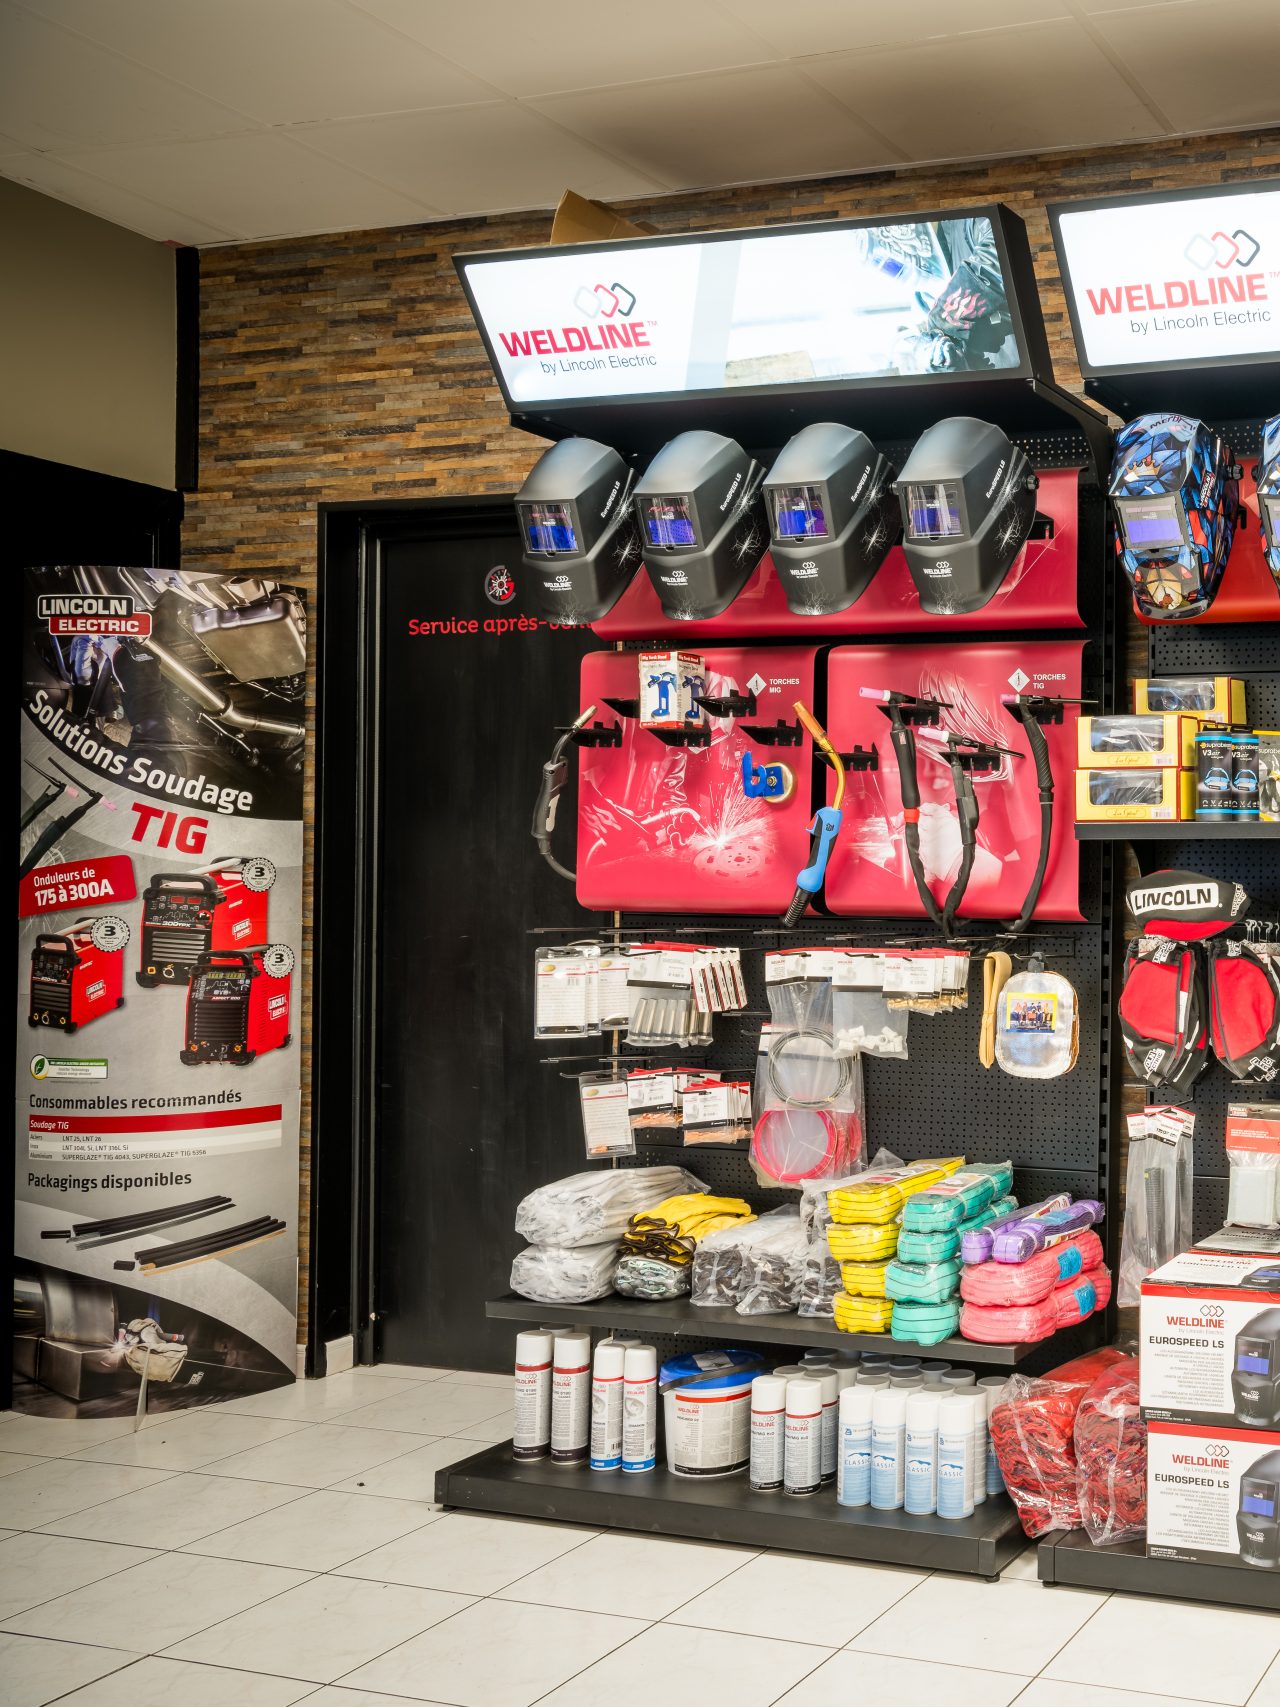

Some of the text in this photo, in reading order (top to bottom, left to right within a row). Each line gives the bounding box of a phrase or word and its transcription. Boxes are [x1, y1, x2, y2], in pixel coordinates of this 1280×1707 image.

[1131, 308, 1271, 336] by Lincoln Electric
[541, 353, 657, 376] by Lincoln Electric
[42, 599, 127, 616] LINCOLN
[58, 619, 140, 633] ELECTRIC
[408, 613, 592, 636] Service après-
[1032, 673, 1067, 681] TORCHES
[769, 686, 782, 694] MIG
[1033, 682, 1045, 690] TIG
[29, 689, 254, 815] Solutions Soudage
[131, 801, 209, 855] TIG
[34, 867, 96, 887] Onduleurs de
[255, 867, 265, 877] 3
[35, 879, 114, 906] 175 à 300A
[1135, 888, 1212, 910] LINCOLN
[104, 926, 116, 937] 3
[274, 953, 285, 964] 3
[29, 1090, 242, 1110] Consommables recommandés
[30, 1119, 69, 1131] Soudage TIG
[28, 1171, 192, 1192] Packagings disponibles
[1166, 1315, 1225, 1329] WELDLINE
[1149, 1335, 1225, 1349] EUROSPEED LS
[1172, 1454, 1230, 1469] WELDLINE
[1155, 1473, 1230, 1489] EUROSPEED LS
